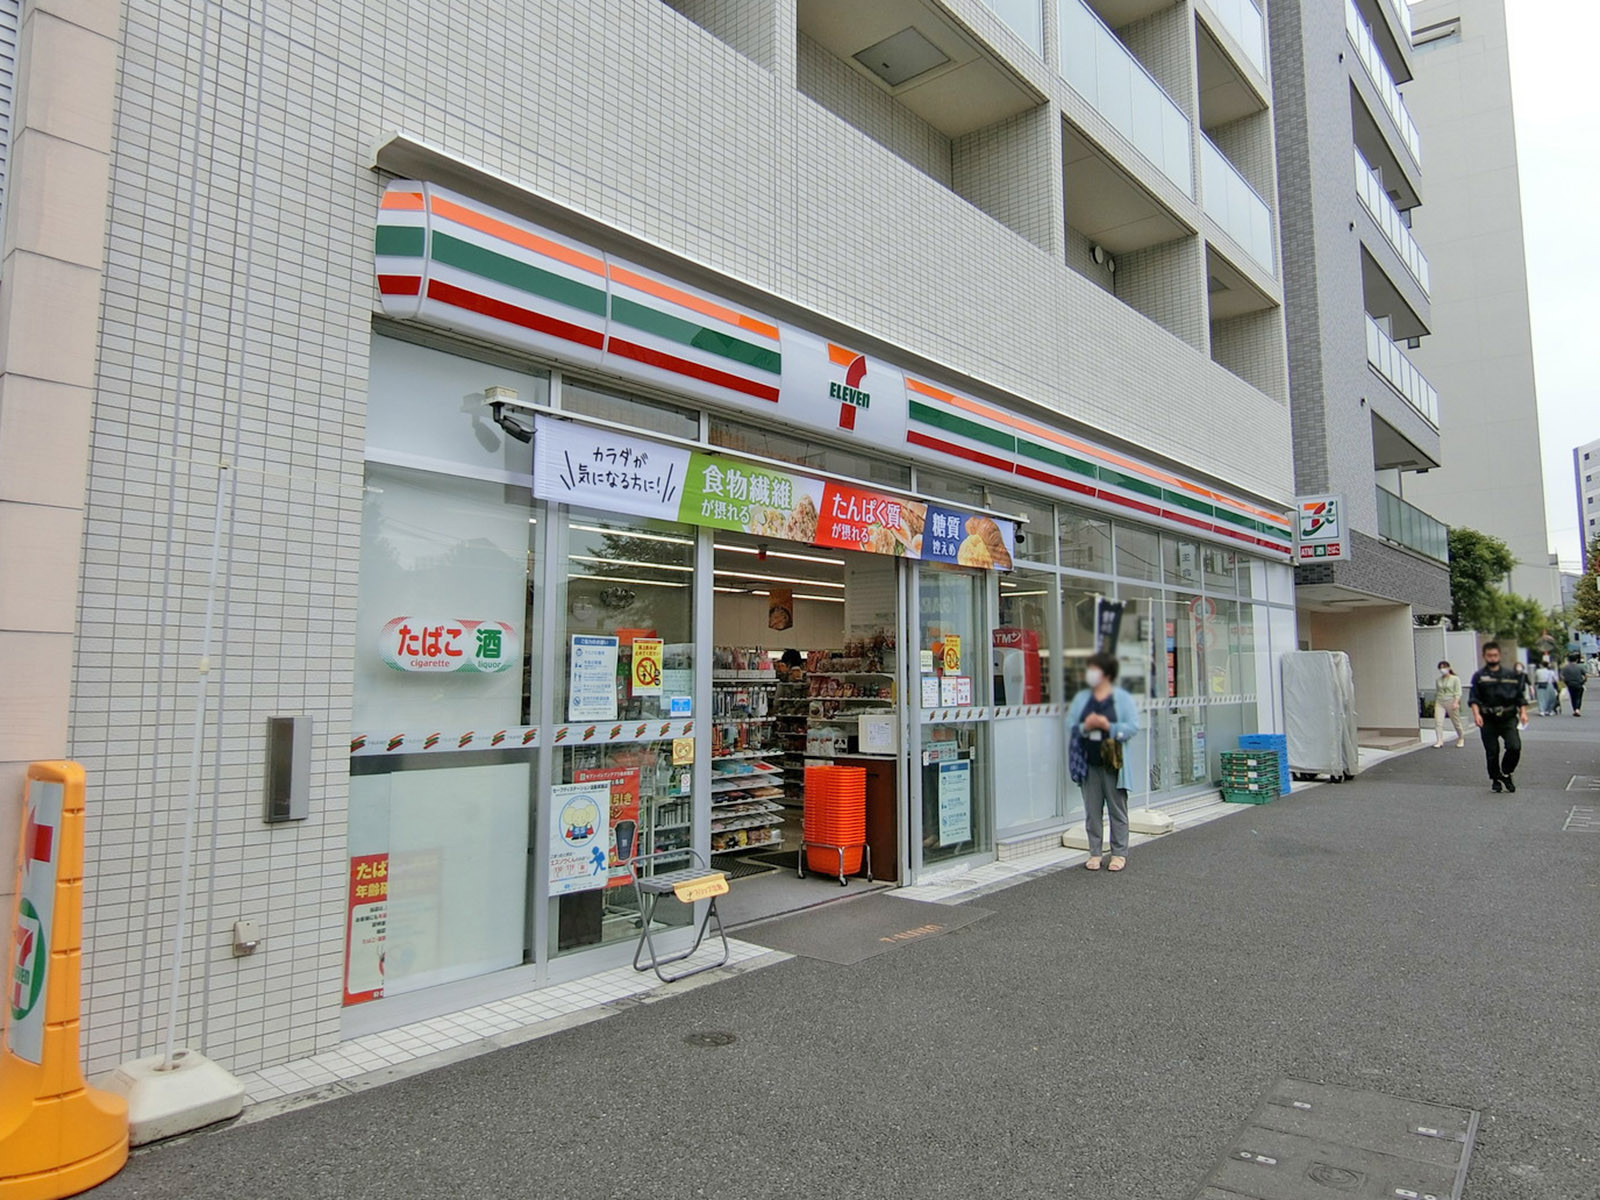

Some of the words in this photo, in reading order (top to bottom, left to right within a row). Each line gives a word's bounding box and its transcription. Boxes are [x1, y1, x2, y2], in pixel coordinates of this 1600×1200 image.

[593, 446, 648, 468] カラダが
[578, 463, 661, 494] 気になる方に!
[702, 464, 792, 510] 食物繊維
[701, 498, 750, 525] が摂れる
[832, 493, 901, 530] たんぱく質
[832, 523, 870, 543] が摂れる
[932, 512, 961, 541] 糖質
[932, 539, 957, 557] 控えめ
[397, 624, 463, 657] たばこ
[475, 628, 502, 659] 酒
[410, 659, 450, 668] cigarette
[478, 660, 501, 669] liquor
